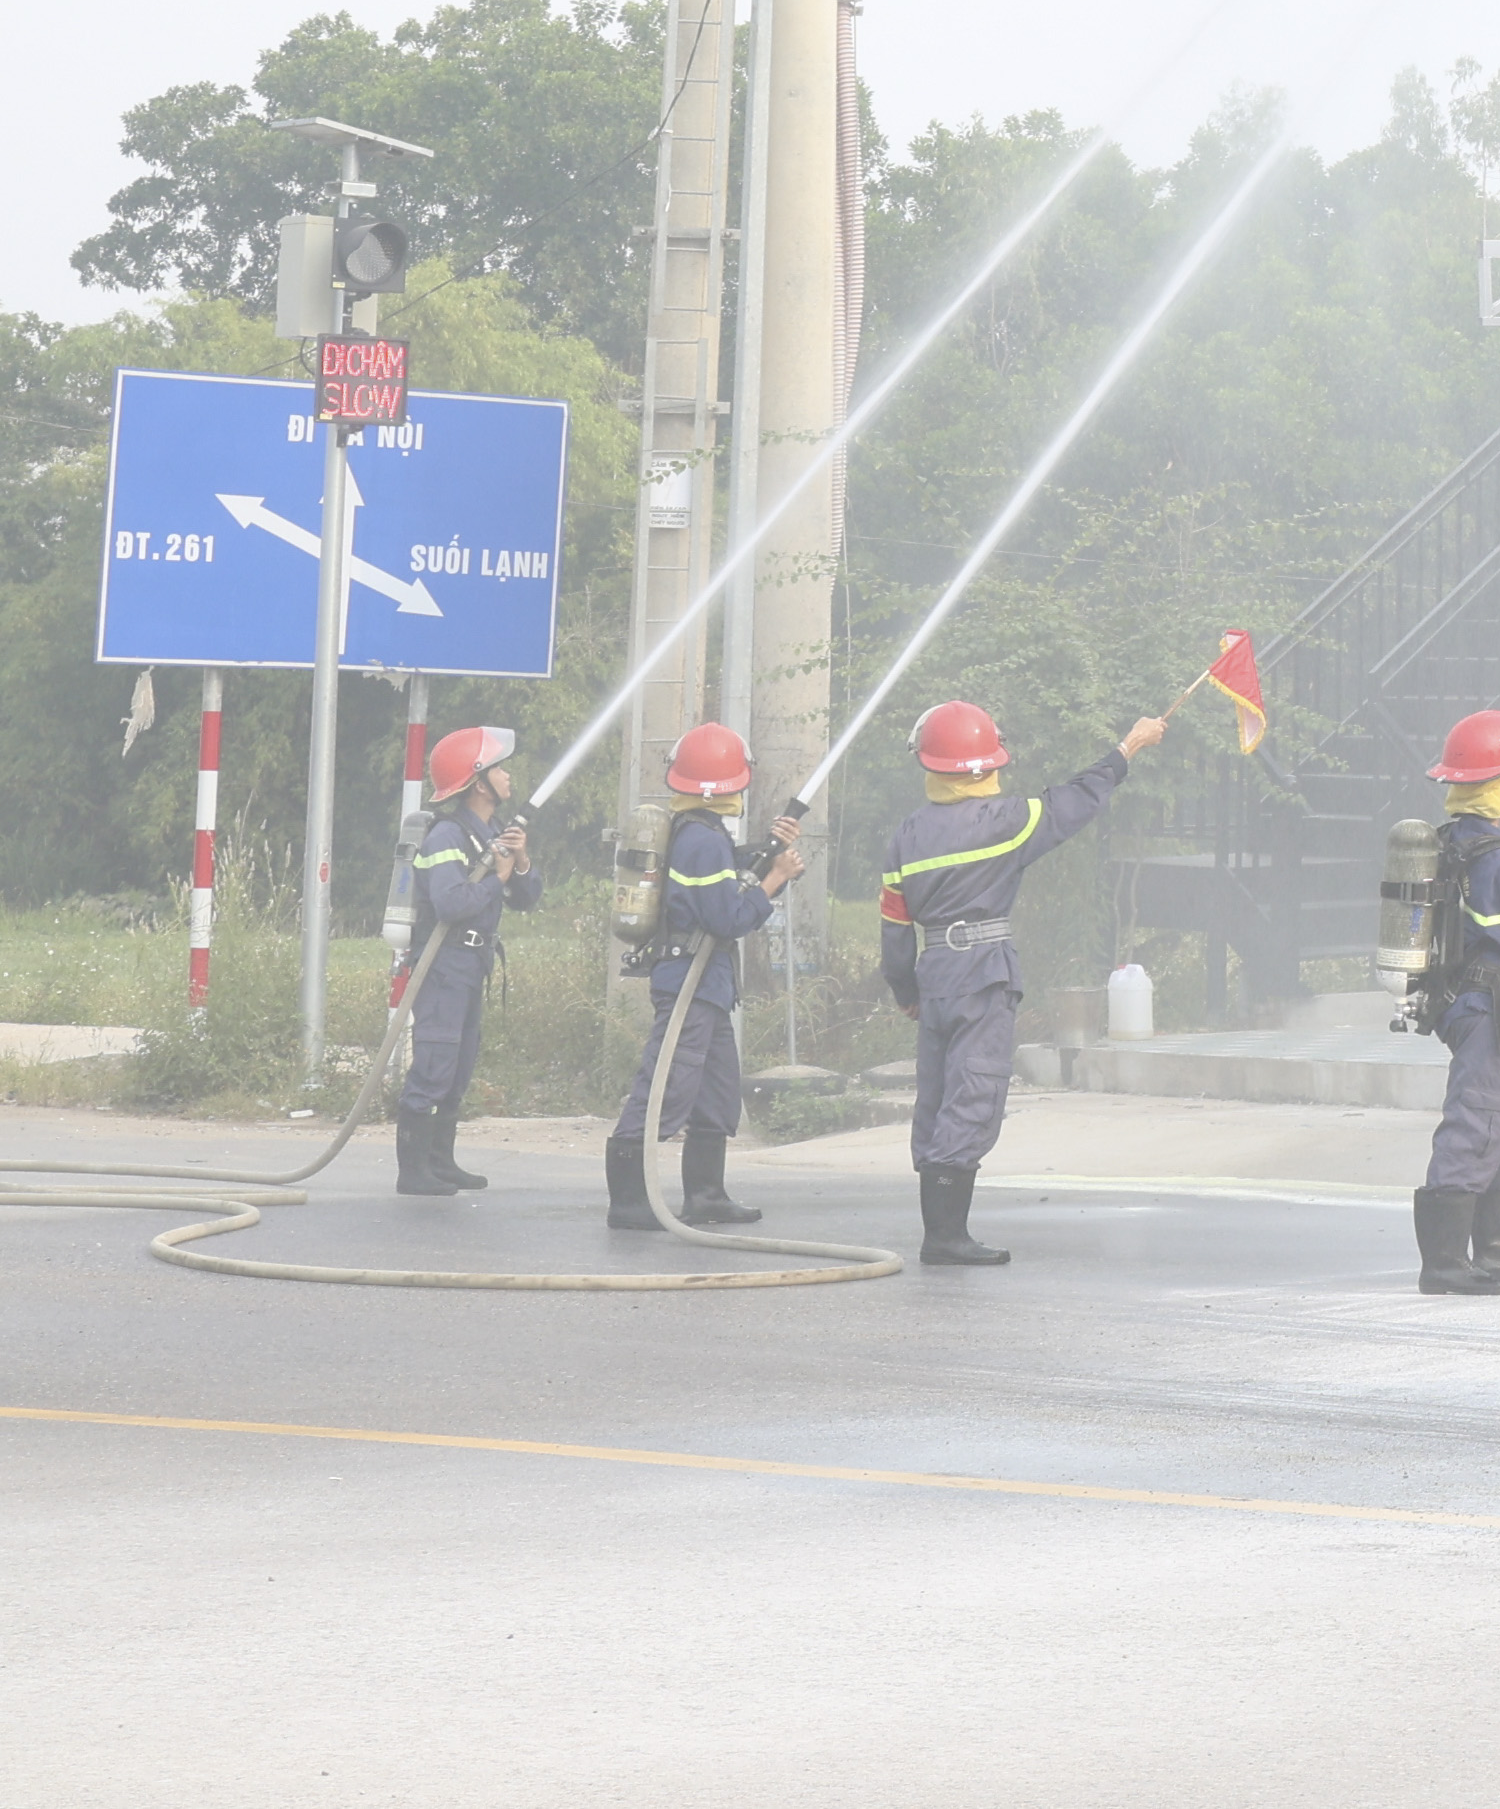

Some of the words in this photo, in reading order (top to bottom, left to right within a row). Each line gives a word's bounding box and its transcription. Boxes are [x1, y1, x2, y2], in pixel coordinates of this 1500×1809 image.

[322, 383, 402, 418] SLOW
[288, 415, 314, 443] ĐI
[410, 534, 469, 575] SUỐI
[481, 549, 548, 582] LẠNH
